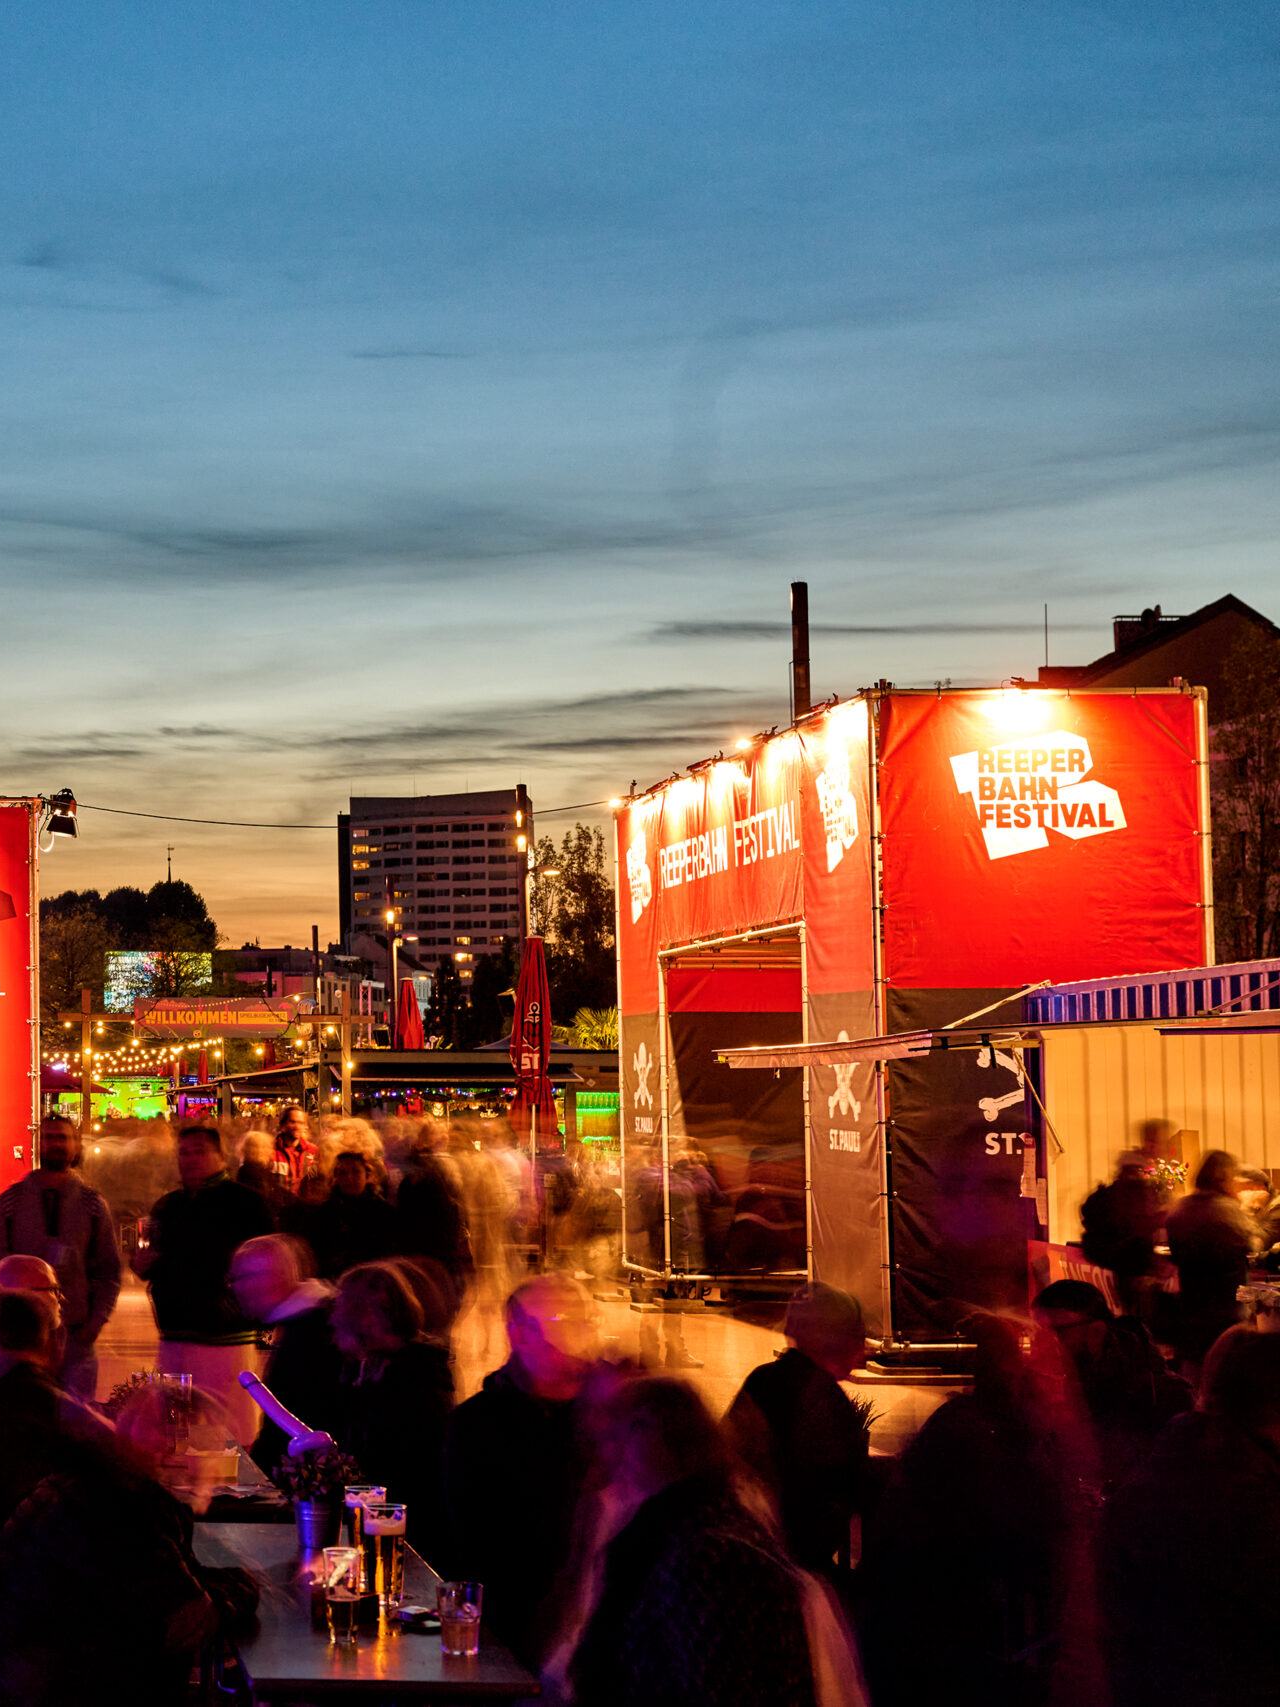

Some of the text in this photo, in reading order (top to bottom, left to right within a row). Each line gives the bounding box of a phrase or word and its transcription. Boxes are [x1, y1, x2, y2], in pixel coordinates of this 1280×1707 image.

[977, 748, 1086, 774] REEPER
[978, 775, 1059, 802] BAHN
[978, 802, 1115, 829] FESTIVAL
[659, 824, 729, 890] REEPERBAHN
[733, 799, 801, 868] FESTIVAL
[145, 1010, 238, 1025] WILLKOMMEN
